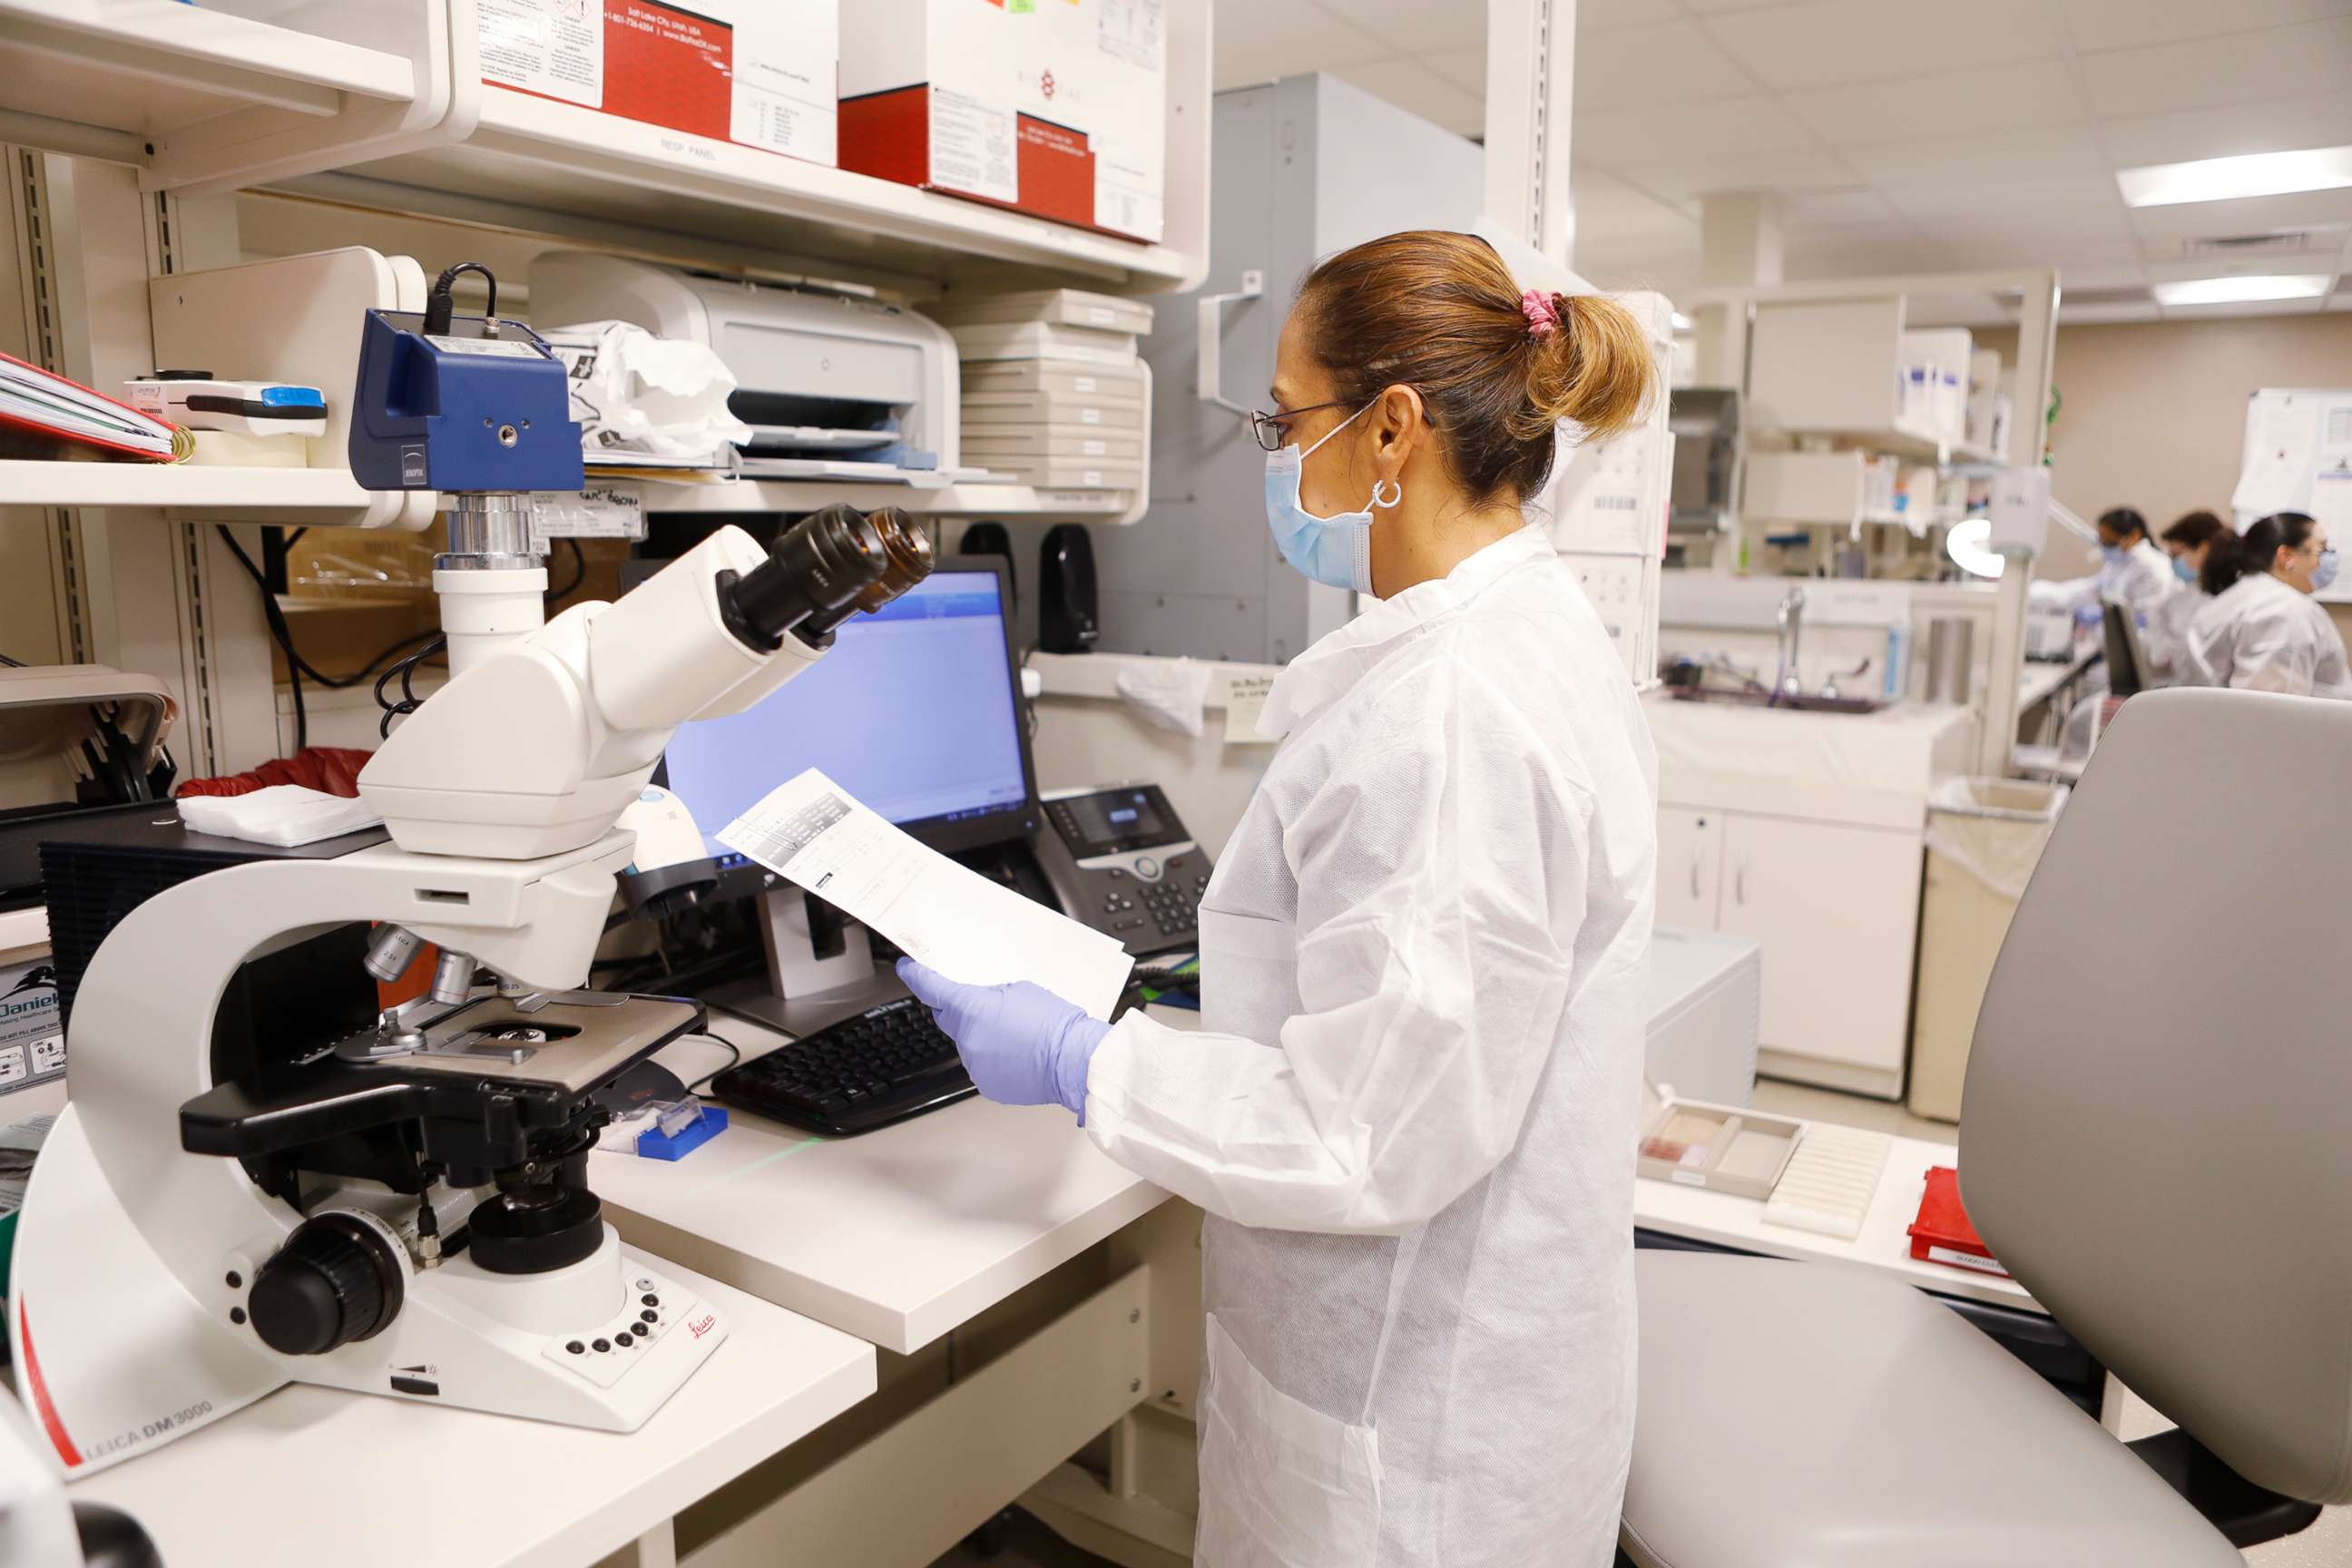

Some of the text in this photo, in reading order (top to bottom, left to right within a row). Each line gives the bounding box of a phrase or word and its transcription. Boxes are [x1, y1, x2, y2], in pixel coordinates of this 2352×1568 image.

[687, 1314, 717, 1339] Leica
[86, 1400, 213, 1461] LEICA DM 3000
